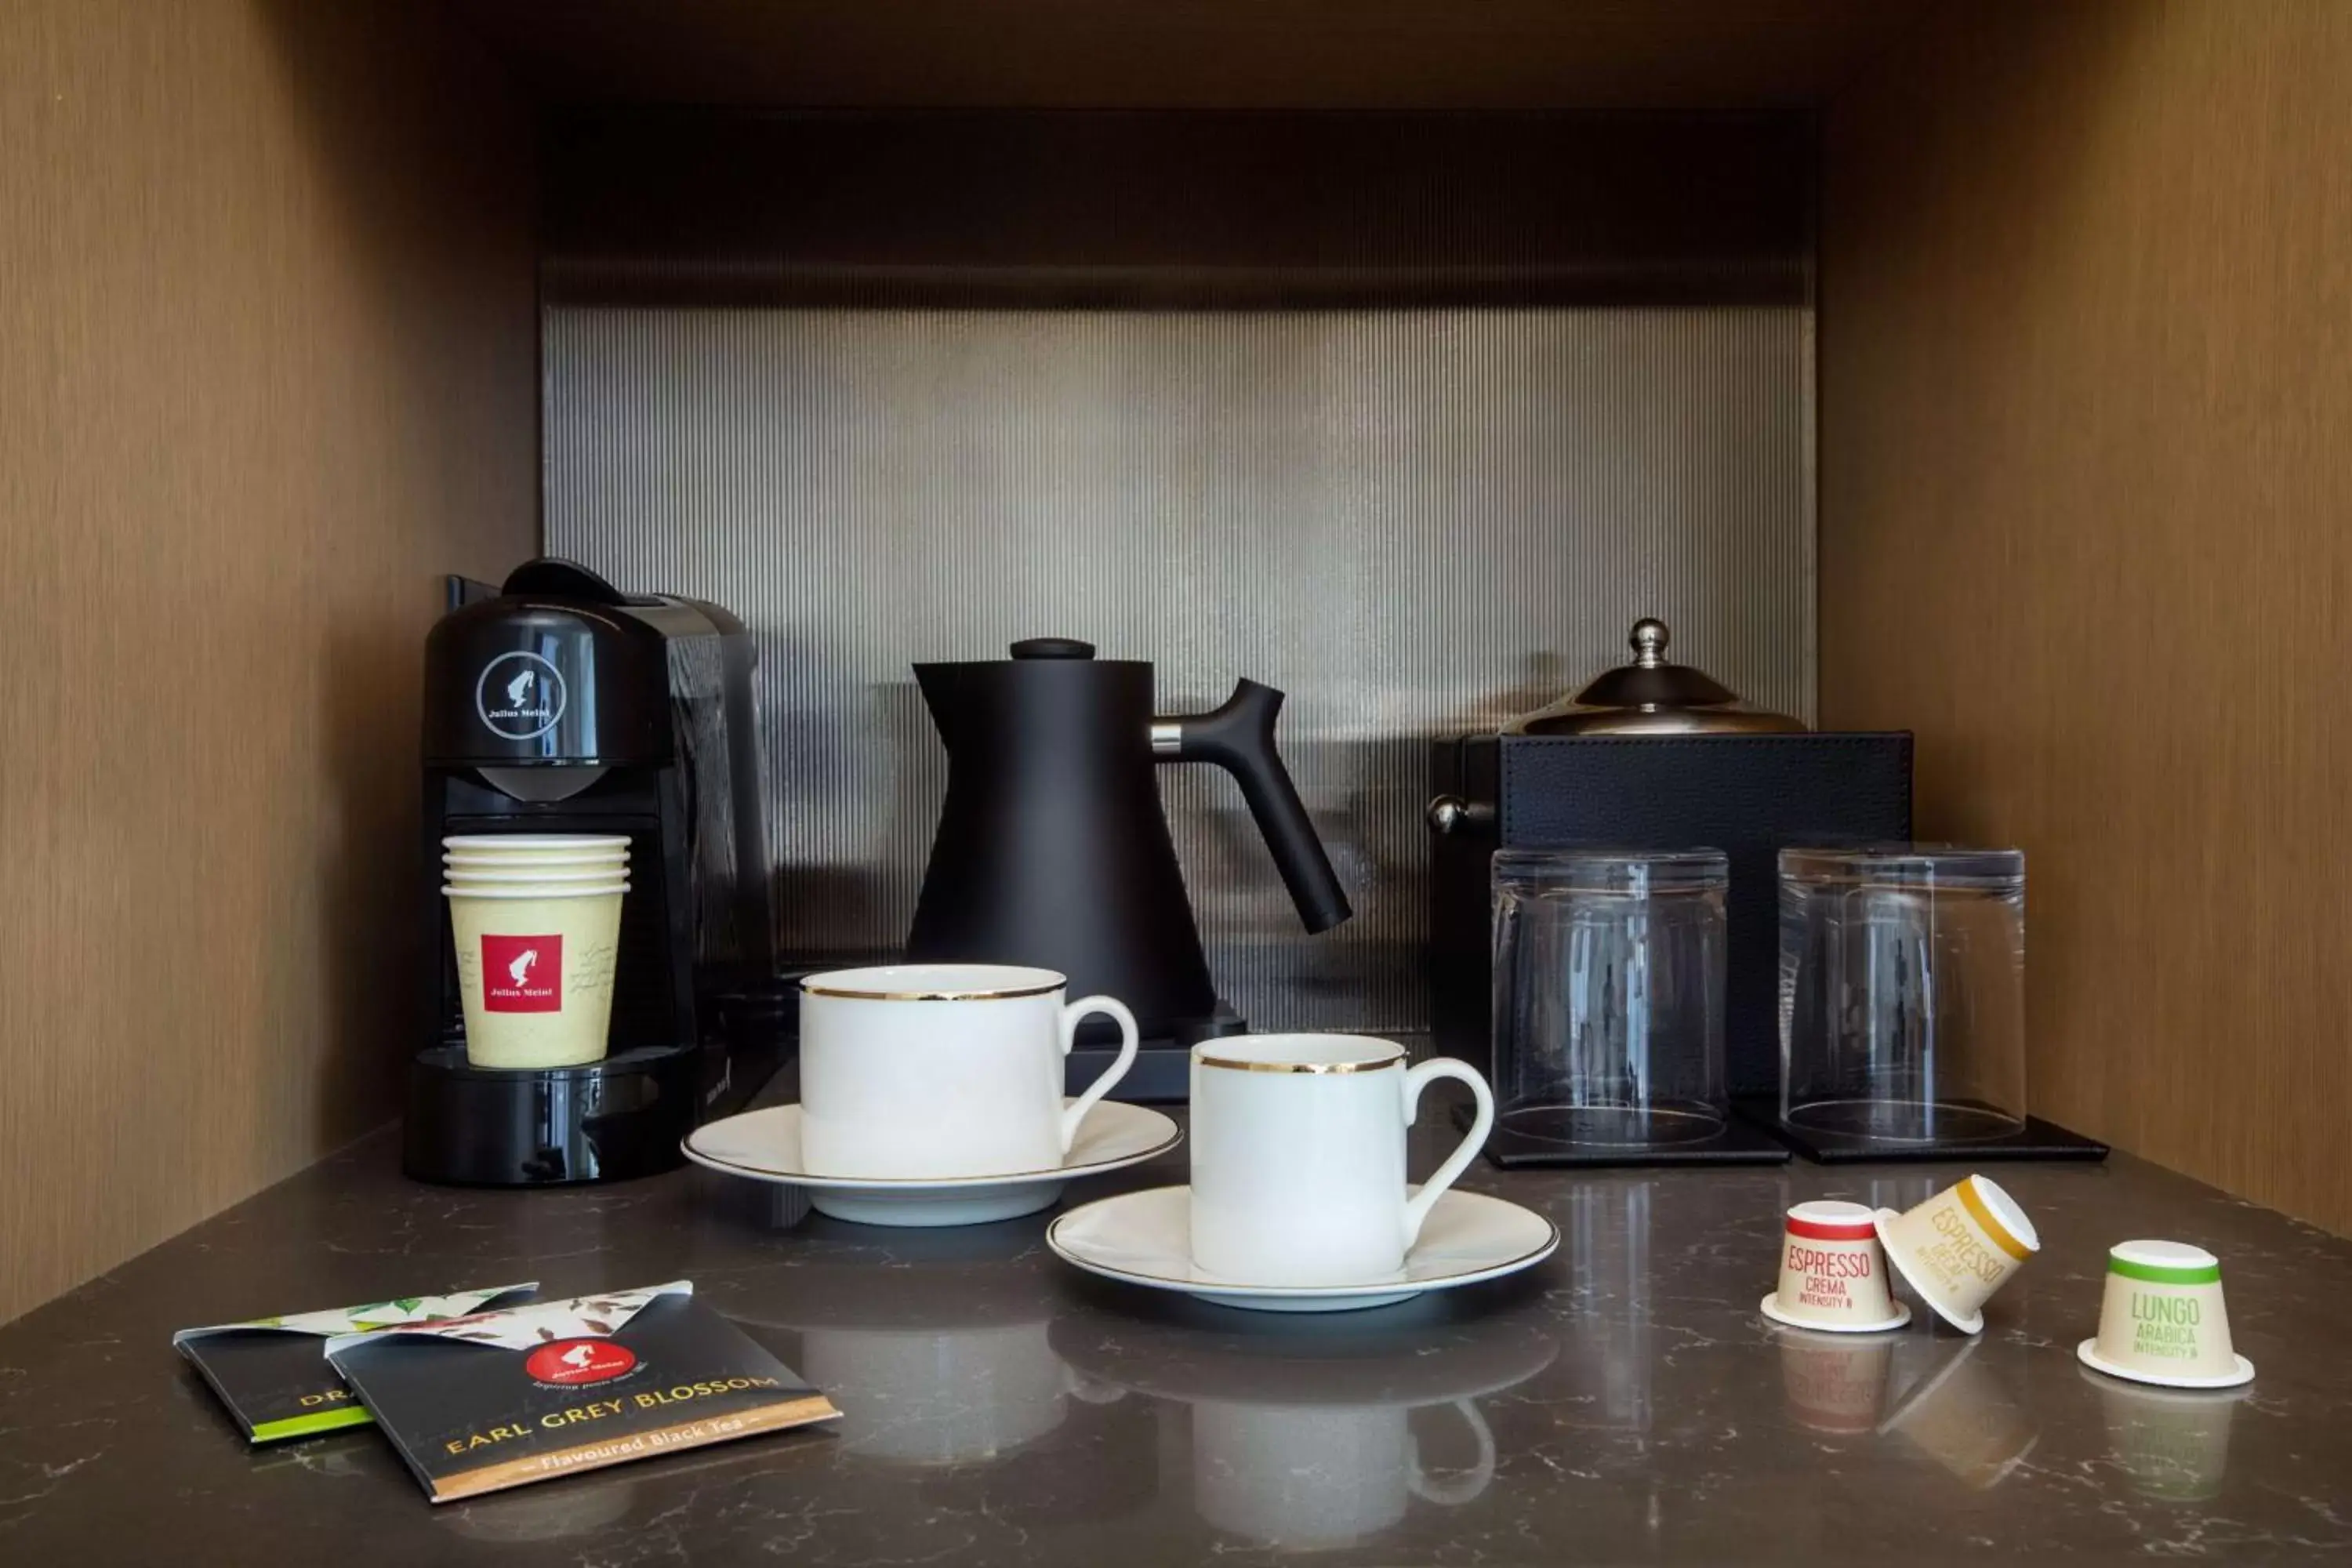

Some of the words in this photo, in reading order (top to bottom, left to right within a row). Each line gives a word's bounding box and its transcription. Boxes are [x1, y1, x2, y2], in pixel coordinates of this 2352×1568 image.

[490, 988, 521, 996] Julius
[523, 988, 552, 996] Meinl
[1932, 1207, 2005, 1282] ESPRESSO
[1788, 1245, 1870, 1278] ESPRESSO
[1806, 1276, 1846, 1295] CREMA
[2132, 1292, 2200, 1326] LUNGO
[2136, 1323, 2196, 1344] ARABICA
[445, 1423, 533, 1455] EARL
[541, 1399, 622, 1428] GREY
[634, 1377, 779, 1408] BLOSSOM
[540, 1437, 646, 1470] Flavoured
[650, 1425, 705, 1446] Black
[712, 1418, 744, 1435] Tea
